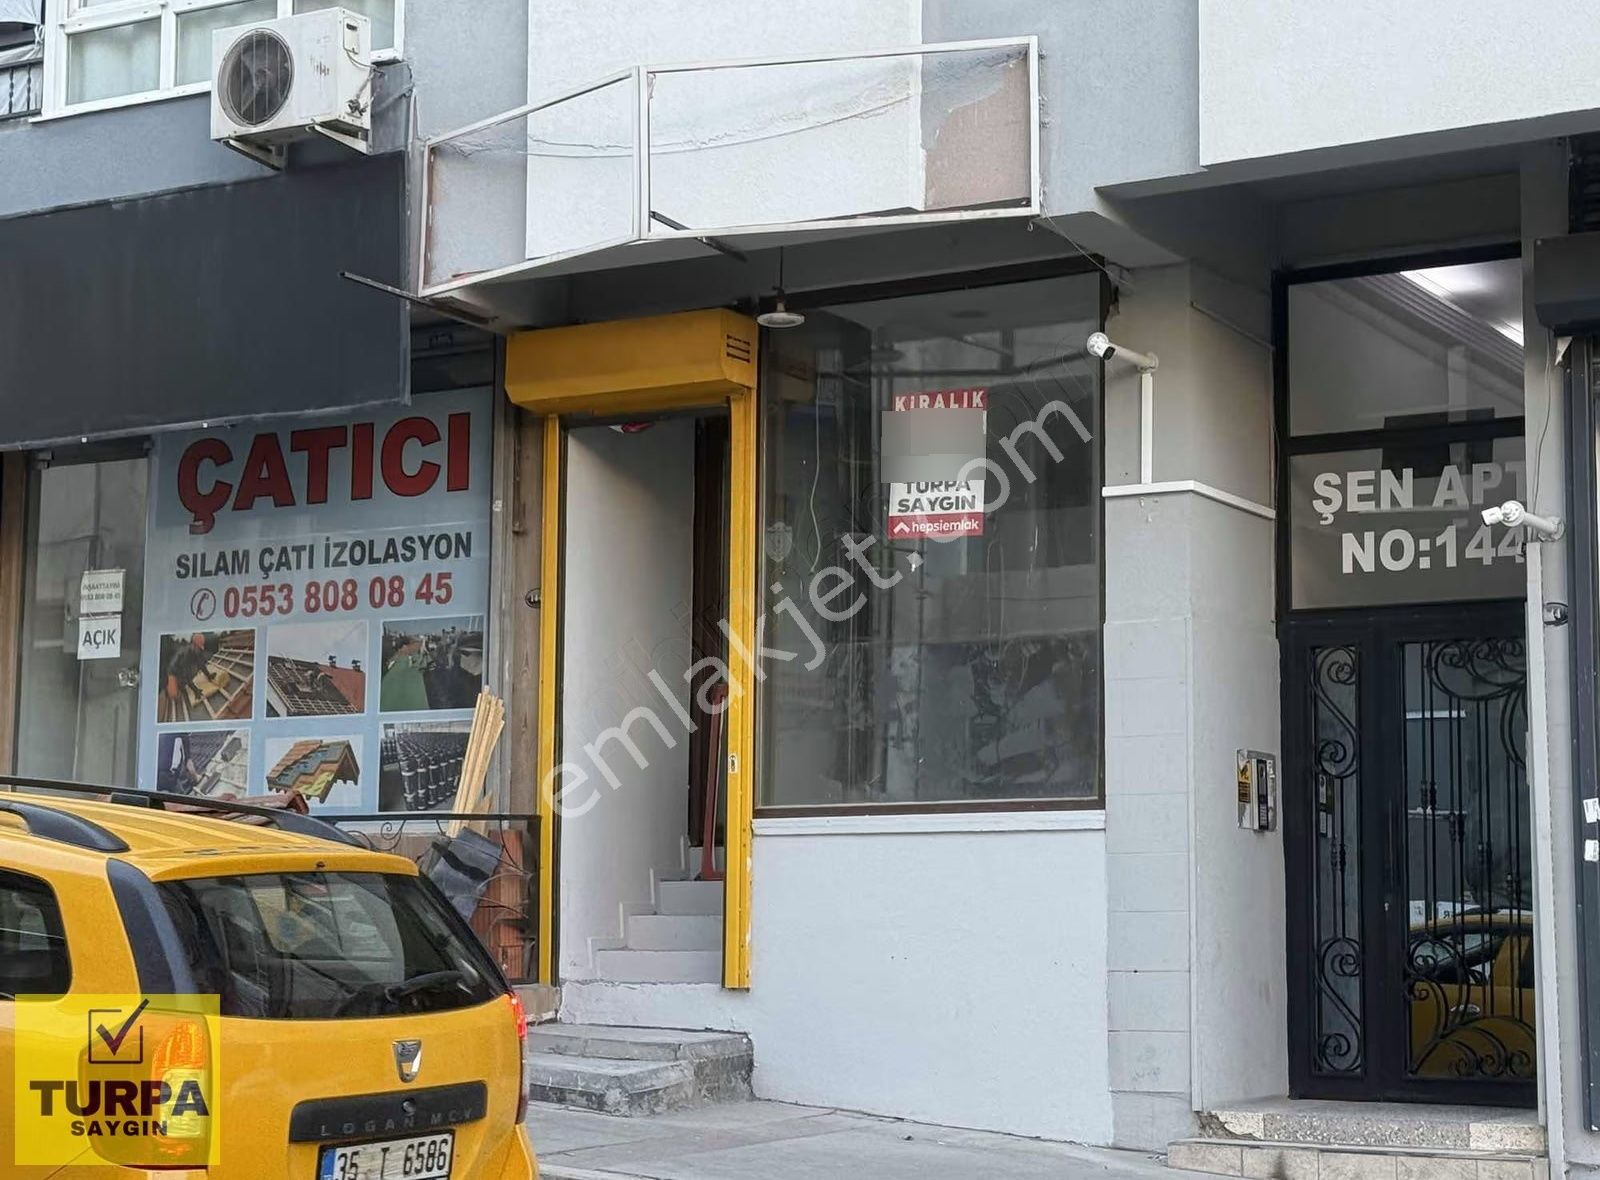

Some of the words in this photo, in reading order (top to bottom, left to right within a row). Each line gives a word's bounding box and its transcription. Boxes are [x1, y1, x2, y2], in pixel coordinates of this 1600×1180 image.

[895, 390, 985, 411] KIRALIK
[177, 412, 472, 535] ÇATICI
[904, 480, 971, 494] TURPA
[1312, 467, 1414, 526] ŞEN
[897, 495, 976, 513] SAYGIN
[911, 517, 979, 535] hepsiemlak
[176, 548, 250, 580] SILAM
[258, 543, 315, 580] ÇATI
[323, 531, 473, 569] İZOLASYON
[223, 582, 294, 619] 0553
[304, 577, 359, 615] 808
[369, 575, 406, 608] 08
[415, 571, 454, 606] 45
[82, 628, 117, 650] AÇIK
[320, 1116, 415, 1137] LOGAN
[337, 1150, 360, 1180] 35
[381, 1146, 390, 1180] T
[403, 1138, 449, 1176] 6586
